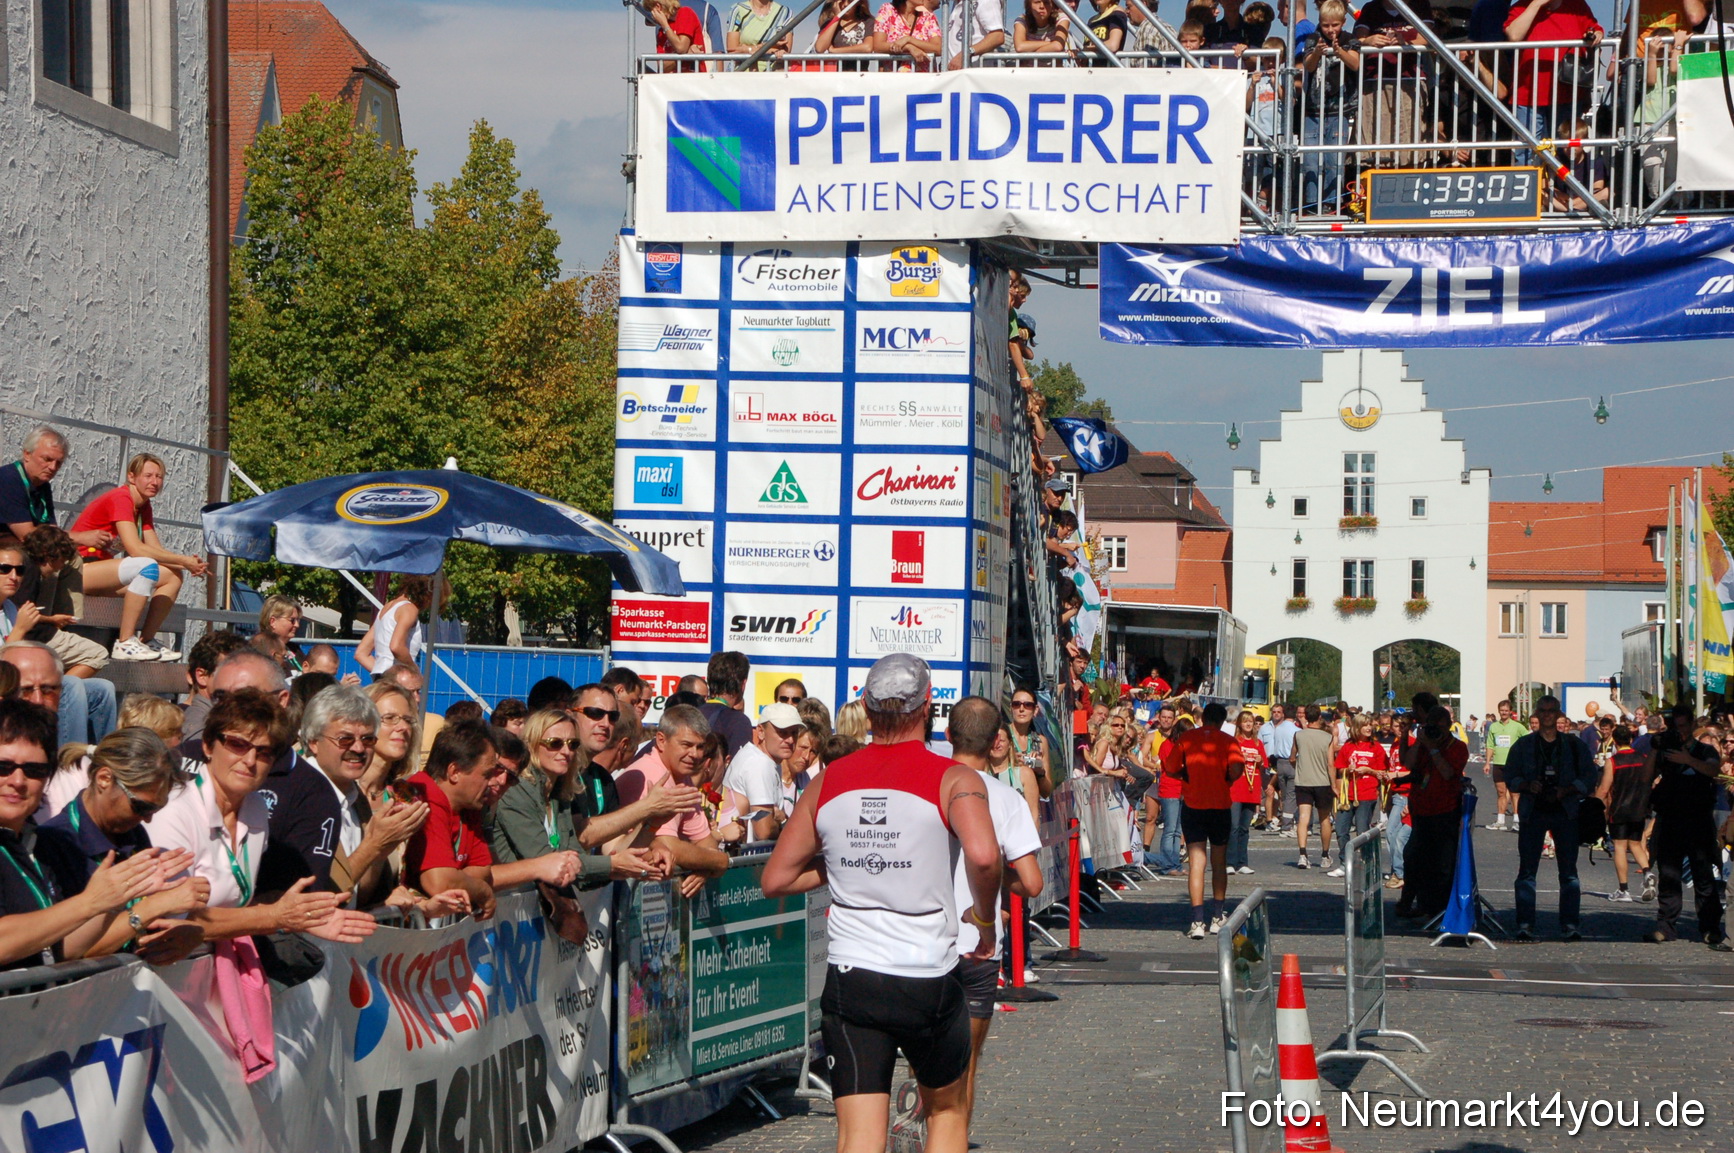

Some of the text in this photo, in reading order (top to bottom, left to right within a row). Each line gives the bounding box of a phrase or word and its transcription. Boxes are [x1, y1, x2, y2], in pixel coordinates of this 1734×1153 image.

[788, 91, 1214, 165] PFLEIDERER
[786, 178, 1214, 215] AKTIENGESELLSCHAFT
[1413, 174, 1530, 205] 1:39:03
[756, 264, 841, 280] Fischer
[886, 260, 941, 282] Burgis
[767, 282, 838, 291] Automobile
[1362, 266, 1546, 327] ZIEL
[743, 315, 831, 327] Neumarkter Tagblatt
[1118, 313, 1230, 324] www.mizunoeurope.com
[663, 324, 712, 340] Wagner
[863, 326, 931, 349] MCM
[622, 399, 707, 414] Bretschneider
[860, 404, 896, 412] RECHTS
[920, 405, 963, 413] ANWÄLTE
[767, 410, 837, 422] MAX BÖGL
[860, 418, 963, 428] Mümmler Meier Kölbl
[637, 462, 673, 483] maxi
[661, 482, 679, 498] dsl
[857, 464, 959, 501] Charivari
[890, 498, 964, 507] Ostbayerns Radio
[728, 546, 811, 559] NÜRNBERGER
[728, 560, 810, 568] VERSICHERUNGSGRUPPE
[891, 559, 922, 574] Braun
[619, 607, 665, 618] Sparkasse
[619, 619, 706, 632] Neumarkt-Parsberg
[730, 615, 797, 634] swn
[619, 630, 707, 639] www.sparkasse-neumarkt.de
[729, 634, 814, 643] stadtwerke neumarkt
[870, 626, 942, 644] NEUMARKTER
[877, 644, 934, 653] MINERALBRUNNEN
[313, 817, 335, 857] 1
[846, 829, 901, 841] Häußinger
[696, 935, 771, 978] Mehr Sicherheit
[696, 976, 759, 1019] für Ihr Event!
[559, 1028, 577, 1057] der
[696, 1024, 785, 1066] Miet & Service Line: 09181 6352
